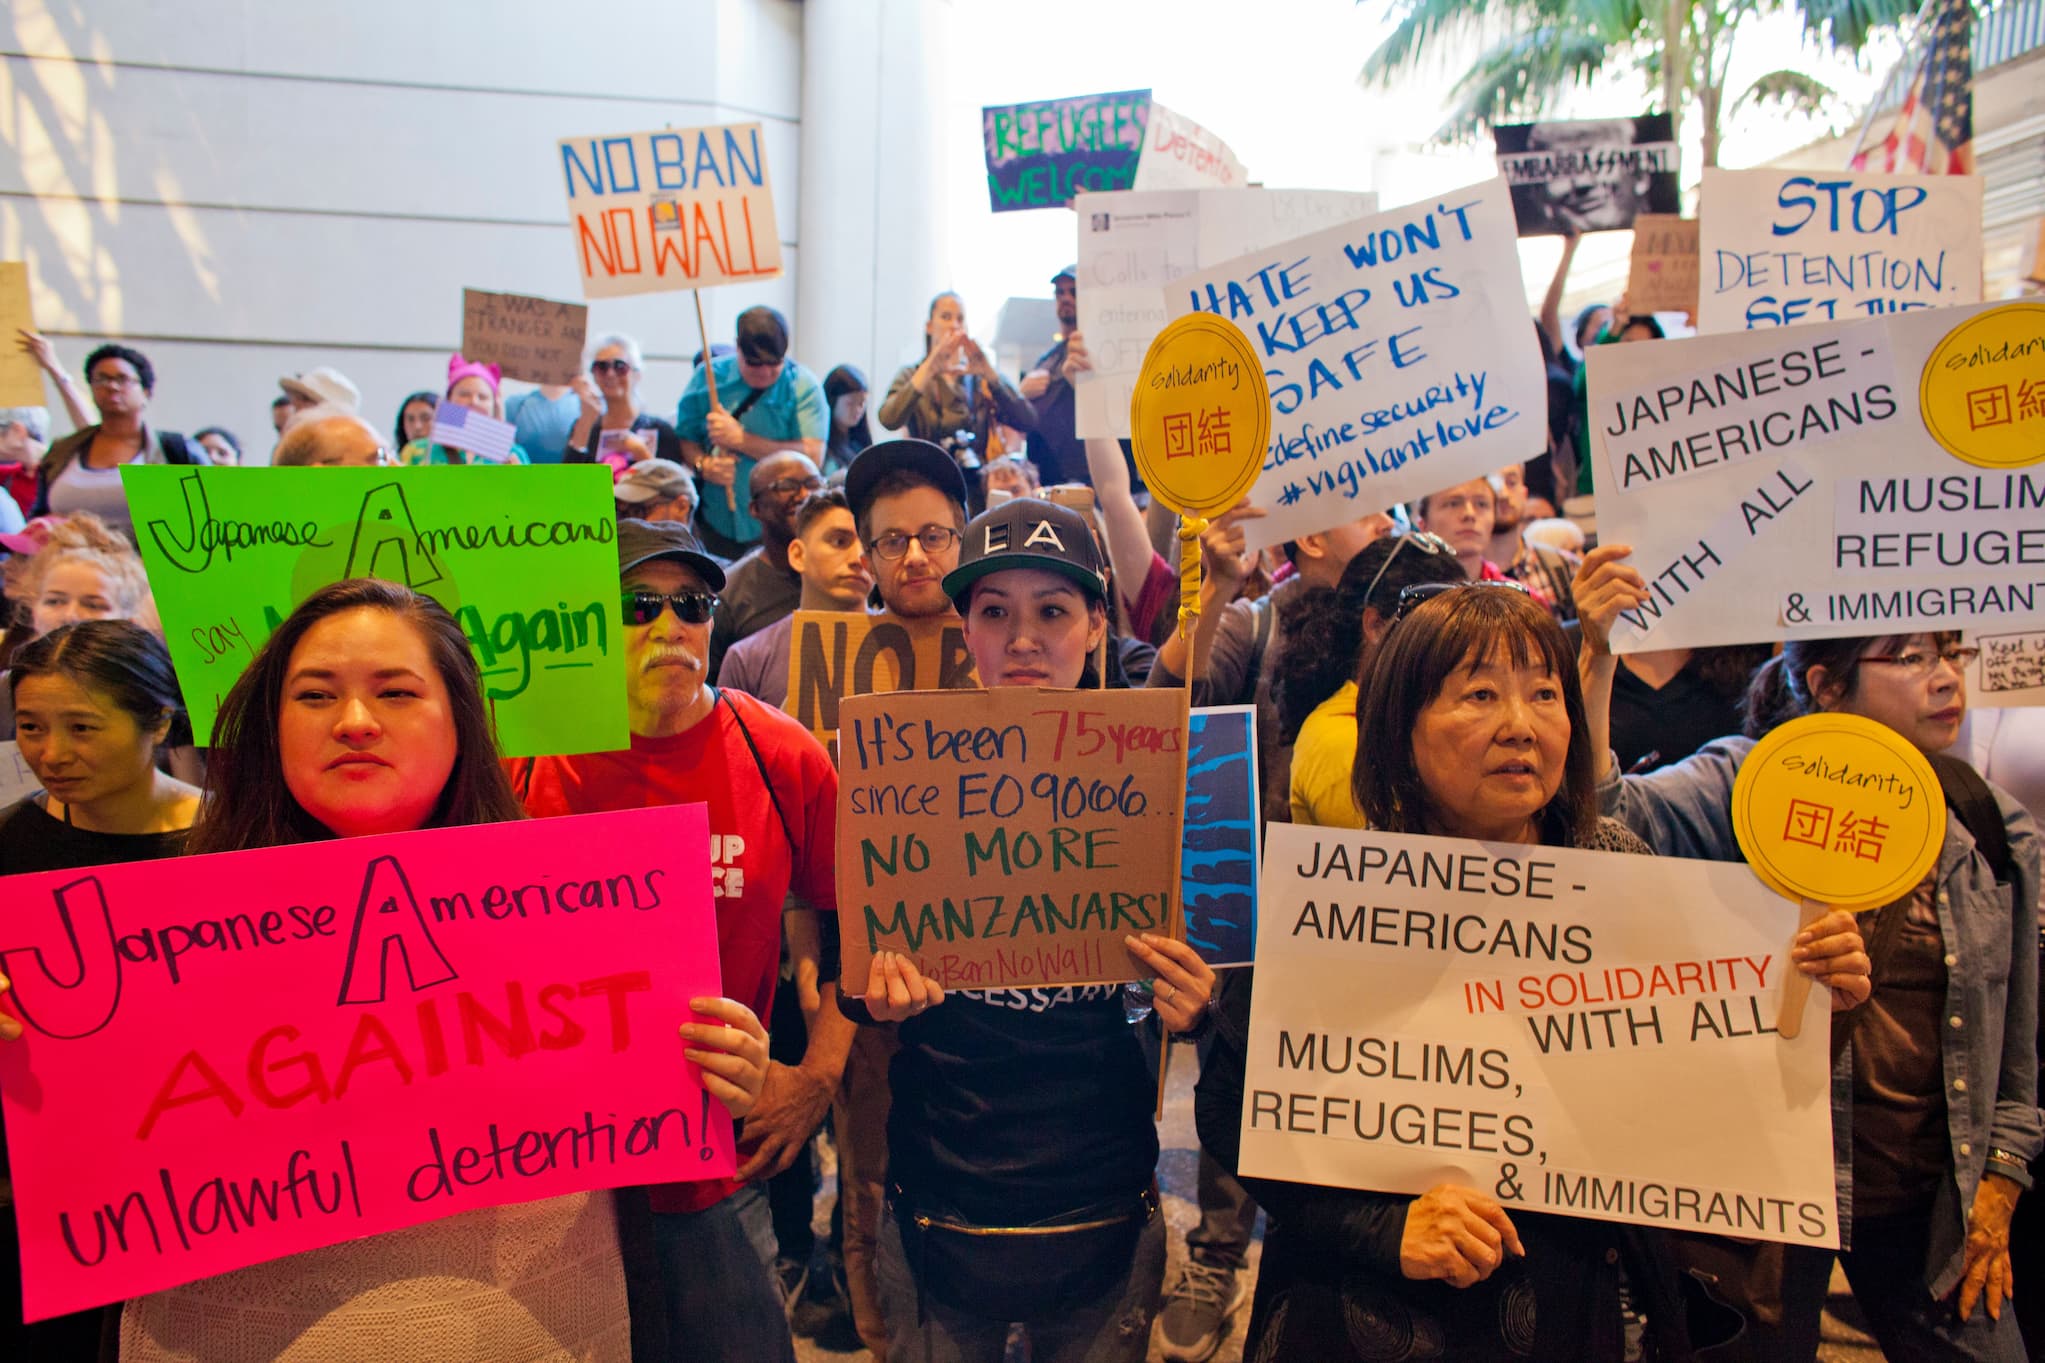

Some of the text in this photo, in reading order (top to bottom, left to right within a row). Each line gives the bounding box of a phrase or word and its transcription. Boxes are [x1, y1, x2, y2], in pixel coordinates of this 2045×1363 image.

[994, 98, 1148, 159] REFUGEES
[561, 128, 763, 198] NO BAN
[988, 160, 1139, 206] WELCOM
[577, 195, 780, 280] NO WALL
[1771, 176, 1928, 236] STOP
[1190, 255, 1311, 319] HATE
[1344, 199, 1484, 270] WON'T
[1714, 249, 1957, 295] DETENTION.
[1257, 266, 1461, 357] KEEP US
[1264, 325, 1428, 415] SAFE
[1606, 339, 1847, 438] JAPANESE
[1163, 405, 1232, 461] 団結
[1263, 423, 1358, 470] edefine
[1623, 384, 1897, 488] AMERICANS
[148, 469, 615, 590] Japanese Americans
[1617, 469, 1814, 633] WITH ALL
[1786, 592, 1812, 623] &
[191, 616, 257, 665] say
[462, 601, 608, 701] Again
[797, 621, 916, 730] NO
[853, 712, 916, 770] It's
[925, 717, 1028, 765] been
[1032, 710, 1106, 763] 75
[1108, 723, 1182, 764] years
[851, 782, 940, 816] since
[958, 772, 1024, 820] EO
[860, 826, 1121, 888] NO MORE
[1783, 797, 1890, 864] 団結
[1296, 841, 1556, 901] JAPANESE
[0, 854, 666, 1041] Japanese Americans
[863, 891, 1169, 955] MANZANARS!
[1292, 901, 1594, 965] AMERICANS
[918, 938, 1104, 988] oBanNoWall
[1463, 954, 1774, 1015] IN SOLIDARITY
[135, 969, 652, 1142] AGAINST
[1528, 996, 1780, 1056] WITH ALL
[1276, 1030, 1524, 1099] MUSLIMS,
[1250, 1089, 1548, 1167] REFUGEES,
[59, 1088, 716, 1269] unlawful detention!
[1494, 1161, 1827, 1239] & IMMIGRANTS
